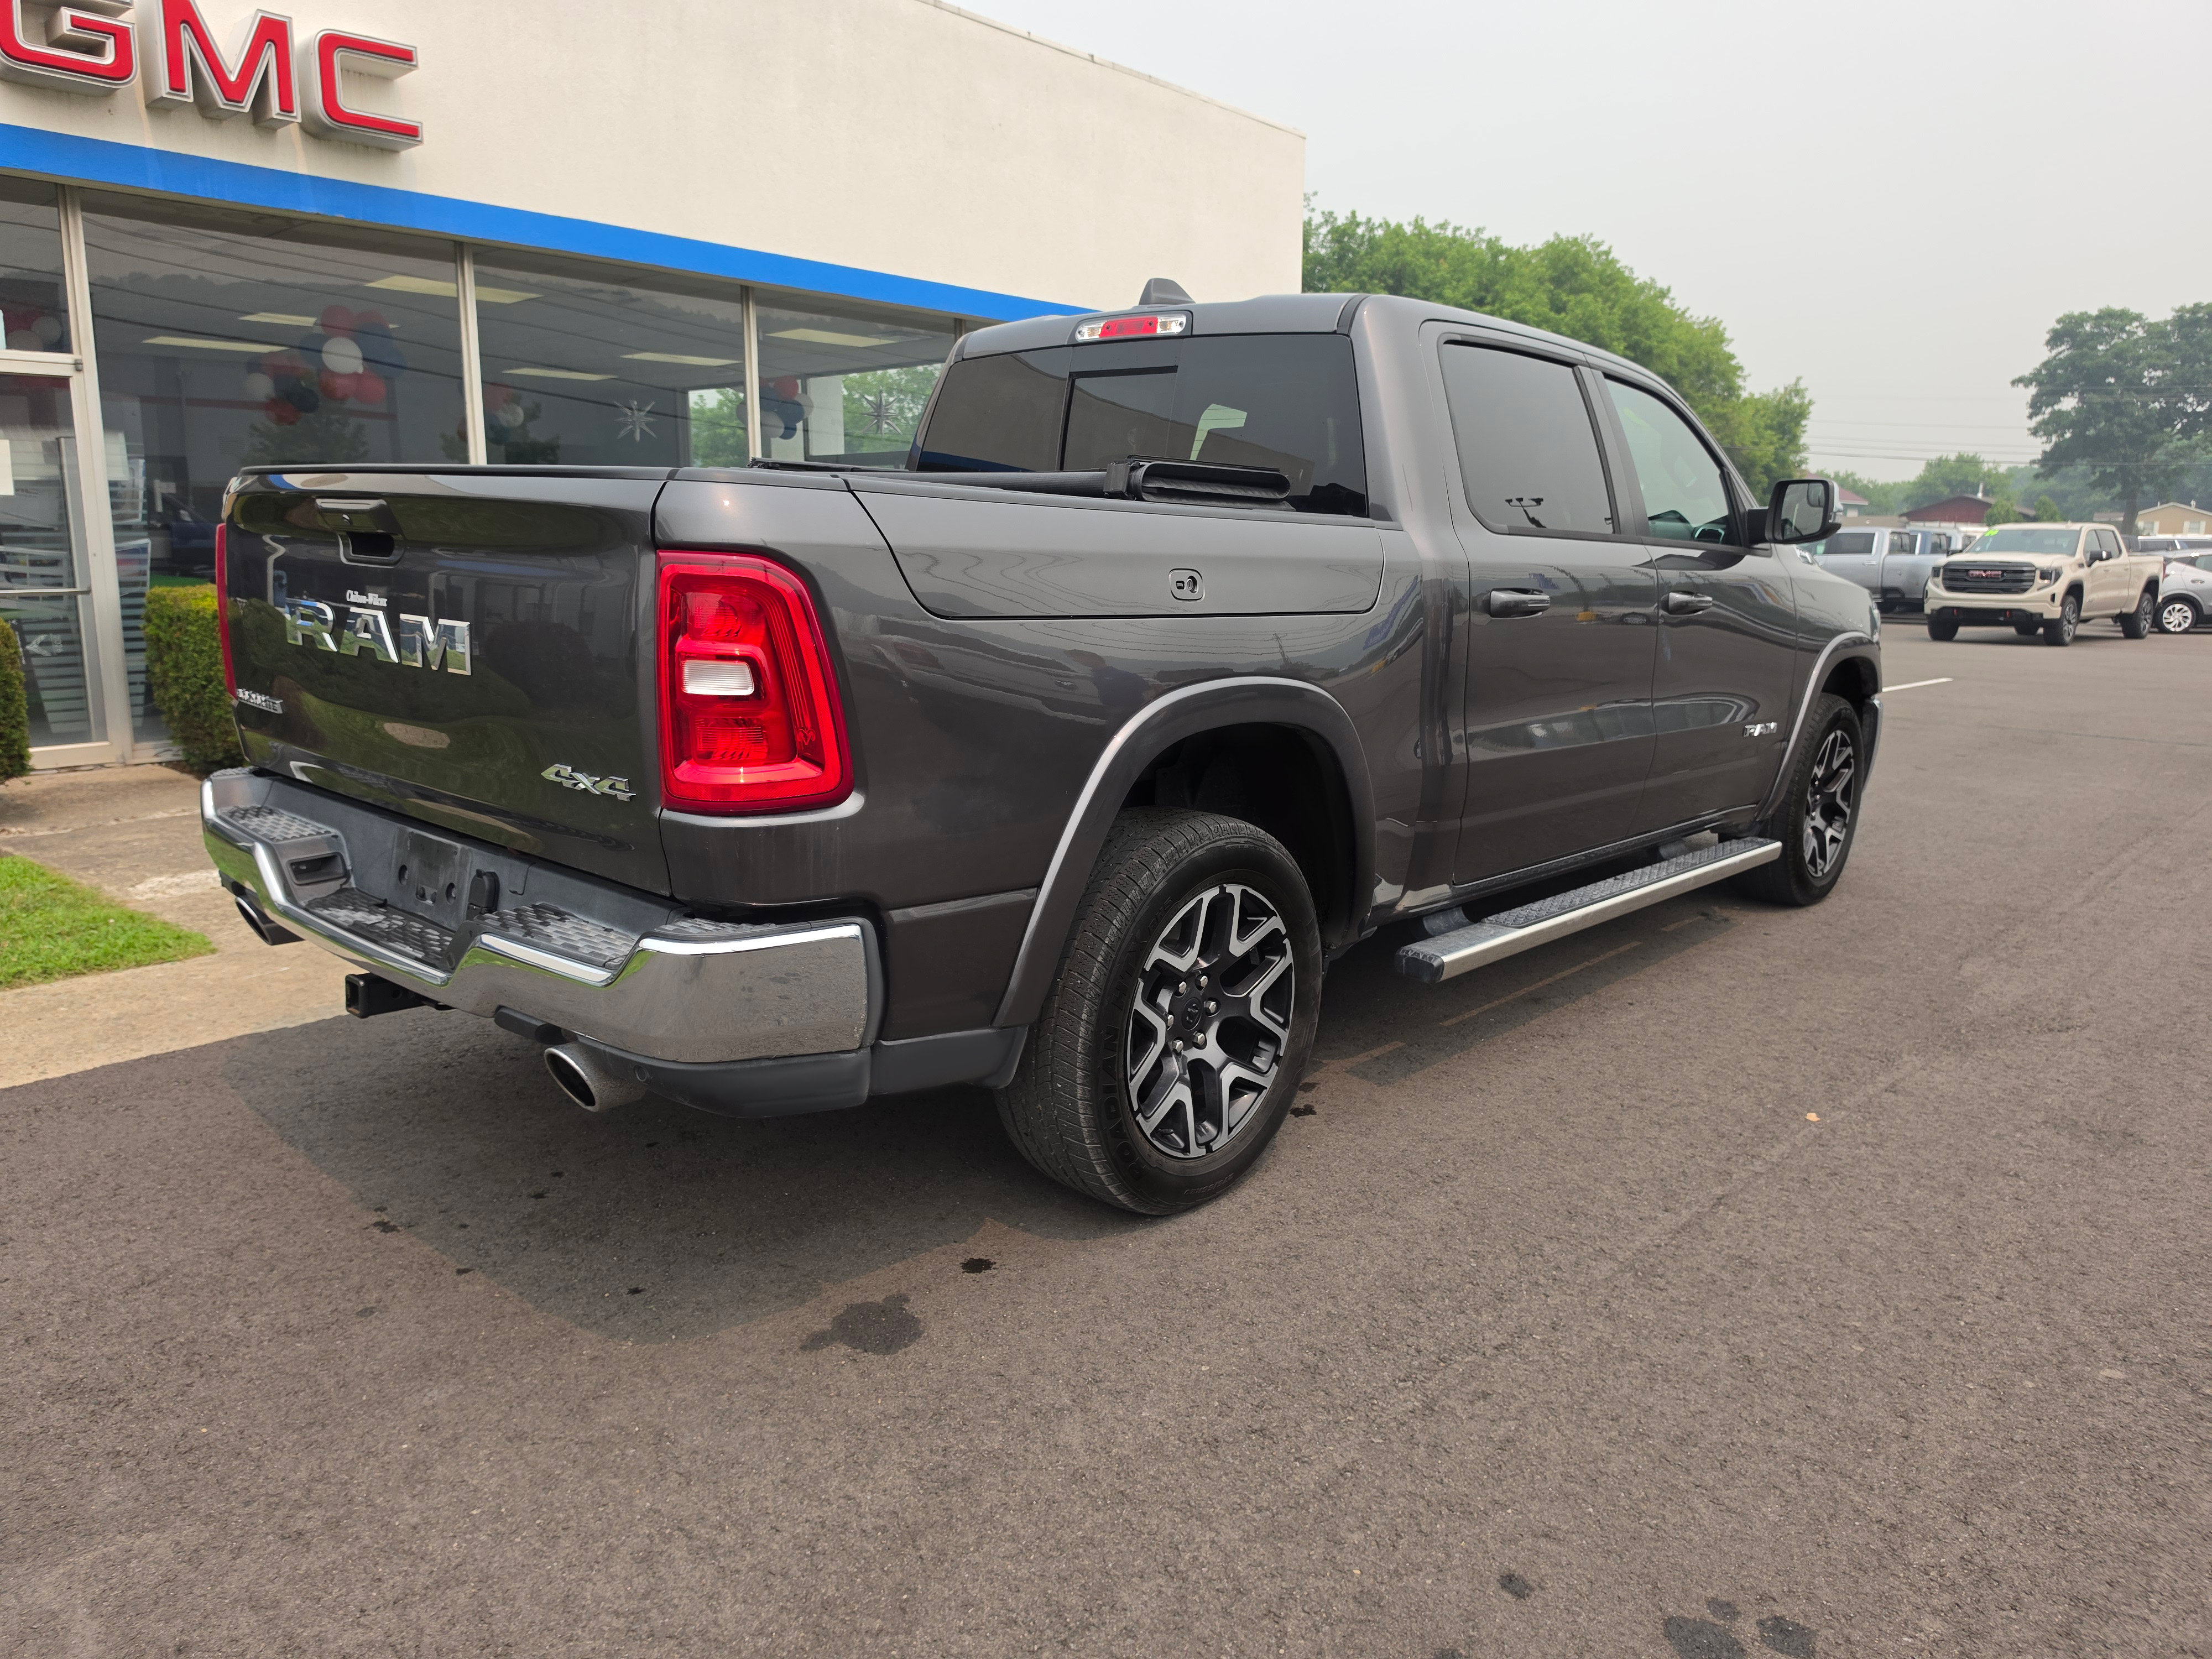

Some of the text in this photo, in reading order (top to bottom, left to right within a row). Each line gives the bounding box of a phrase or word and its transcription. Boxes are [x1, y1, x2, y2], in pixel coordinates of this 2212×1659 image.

[0, 0, 424, 148] GMC
[1968, 570, 2002, 579] GMC
[284, 597, 472, 676] RAM
